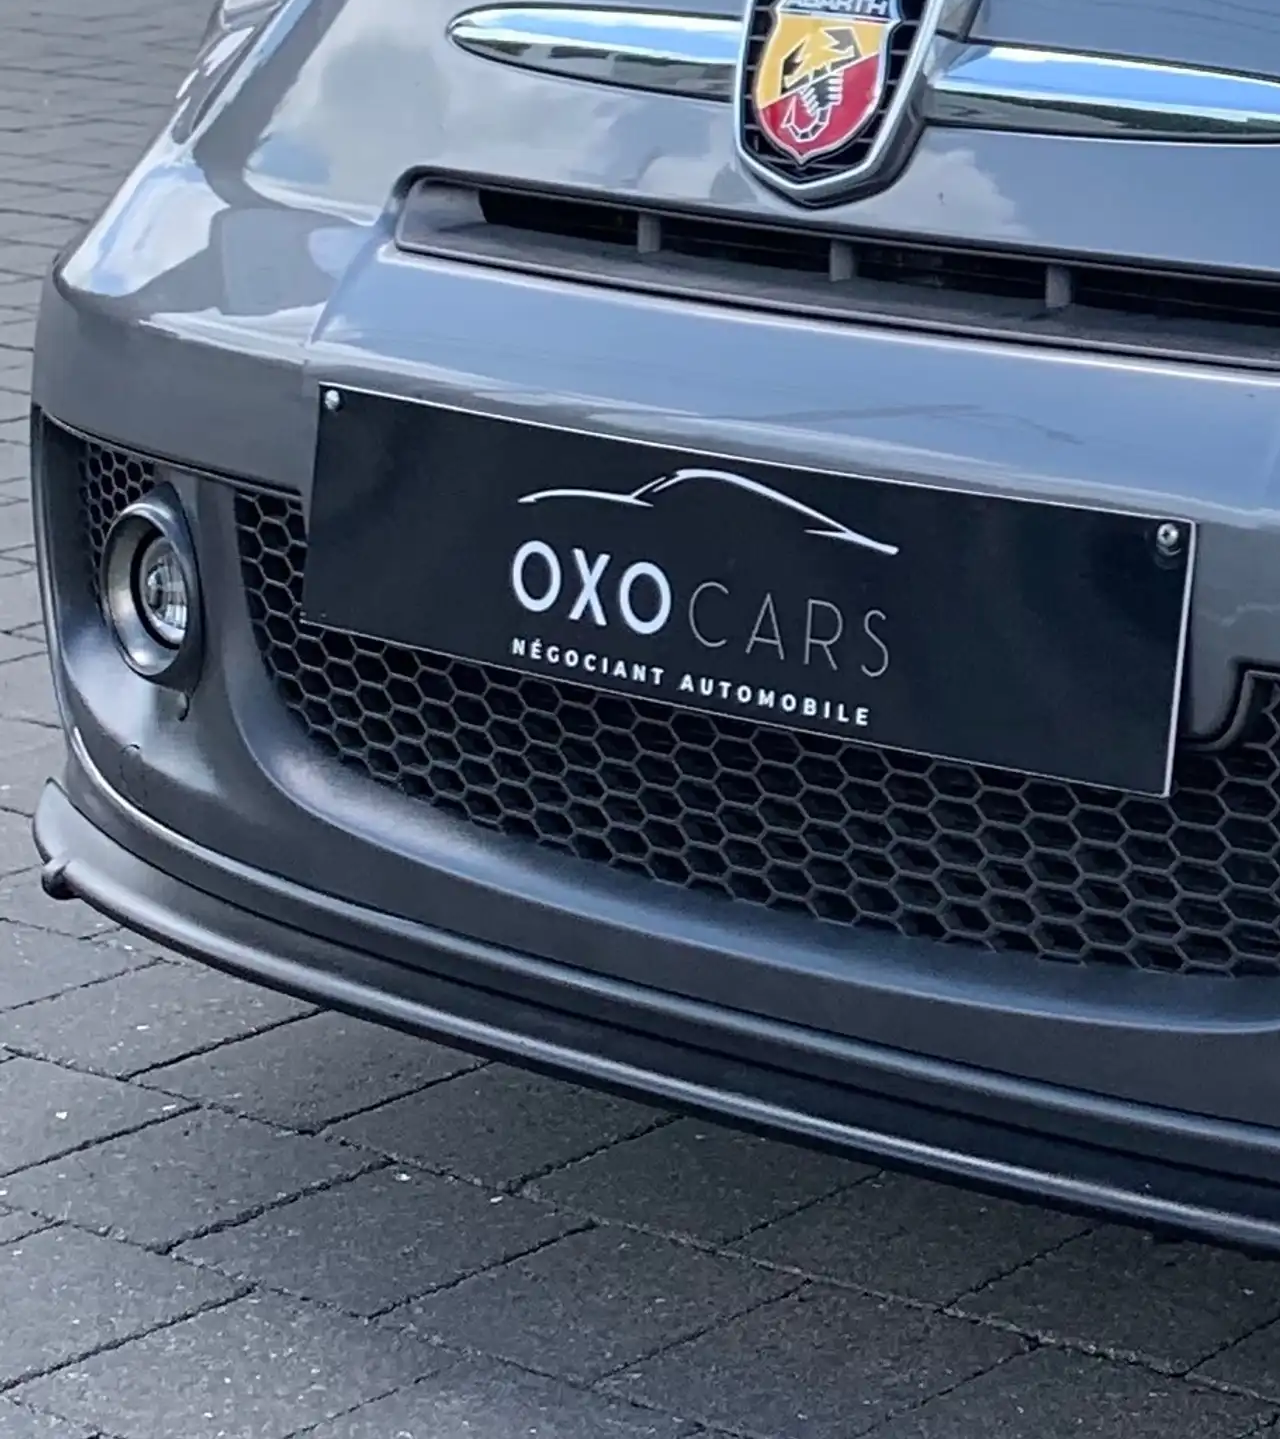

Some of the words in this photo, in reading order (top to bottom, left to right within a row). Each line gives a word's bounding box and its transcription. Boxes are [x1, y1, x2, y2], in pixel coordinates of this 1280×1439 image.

[511, 539, 672, 635] OXO
[688, 581, 889, 678] CARS
[511, 637, 665, 686] NÉGOCIANT
[678, 673, 869, 727] AUTOMOBILE
